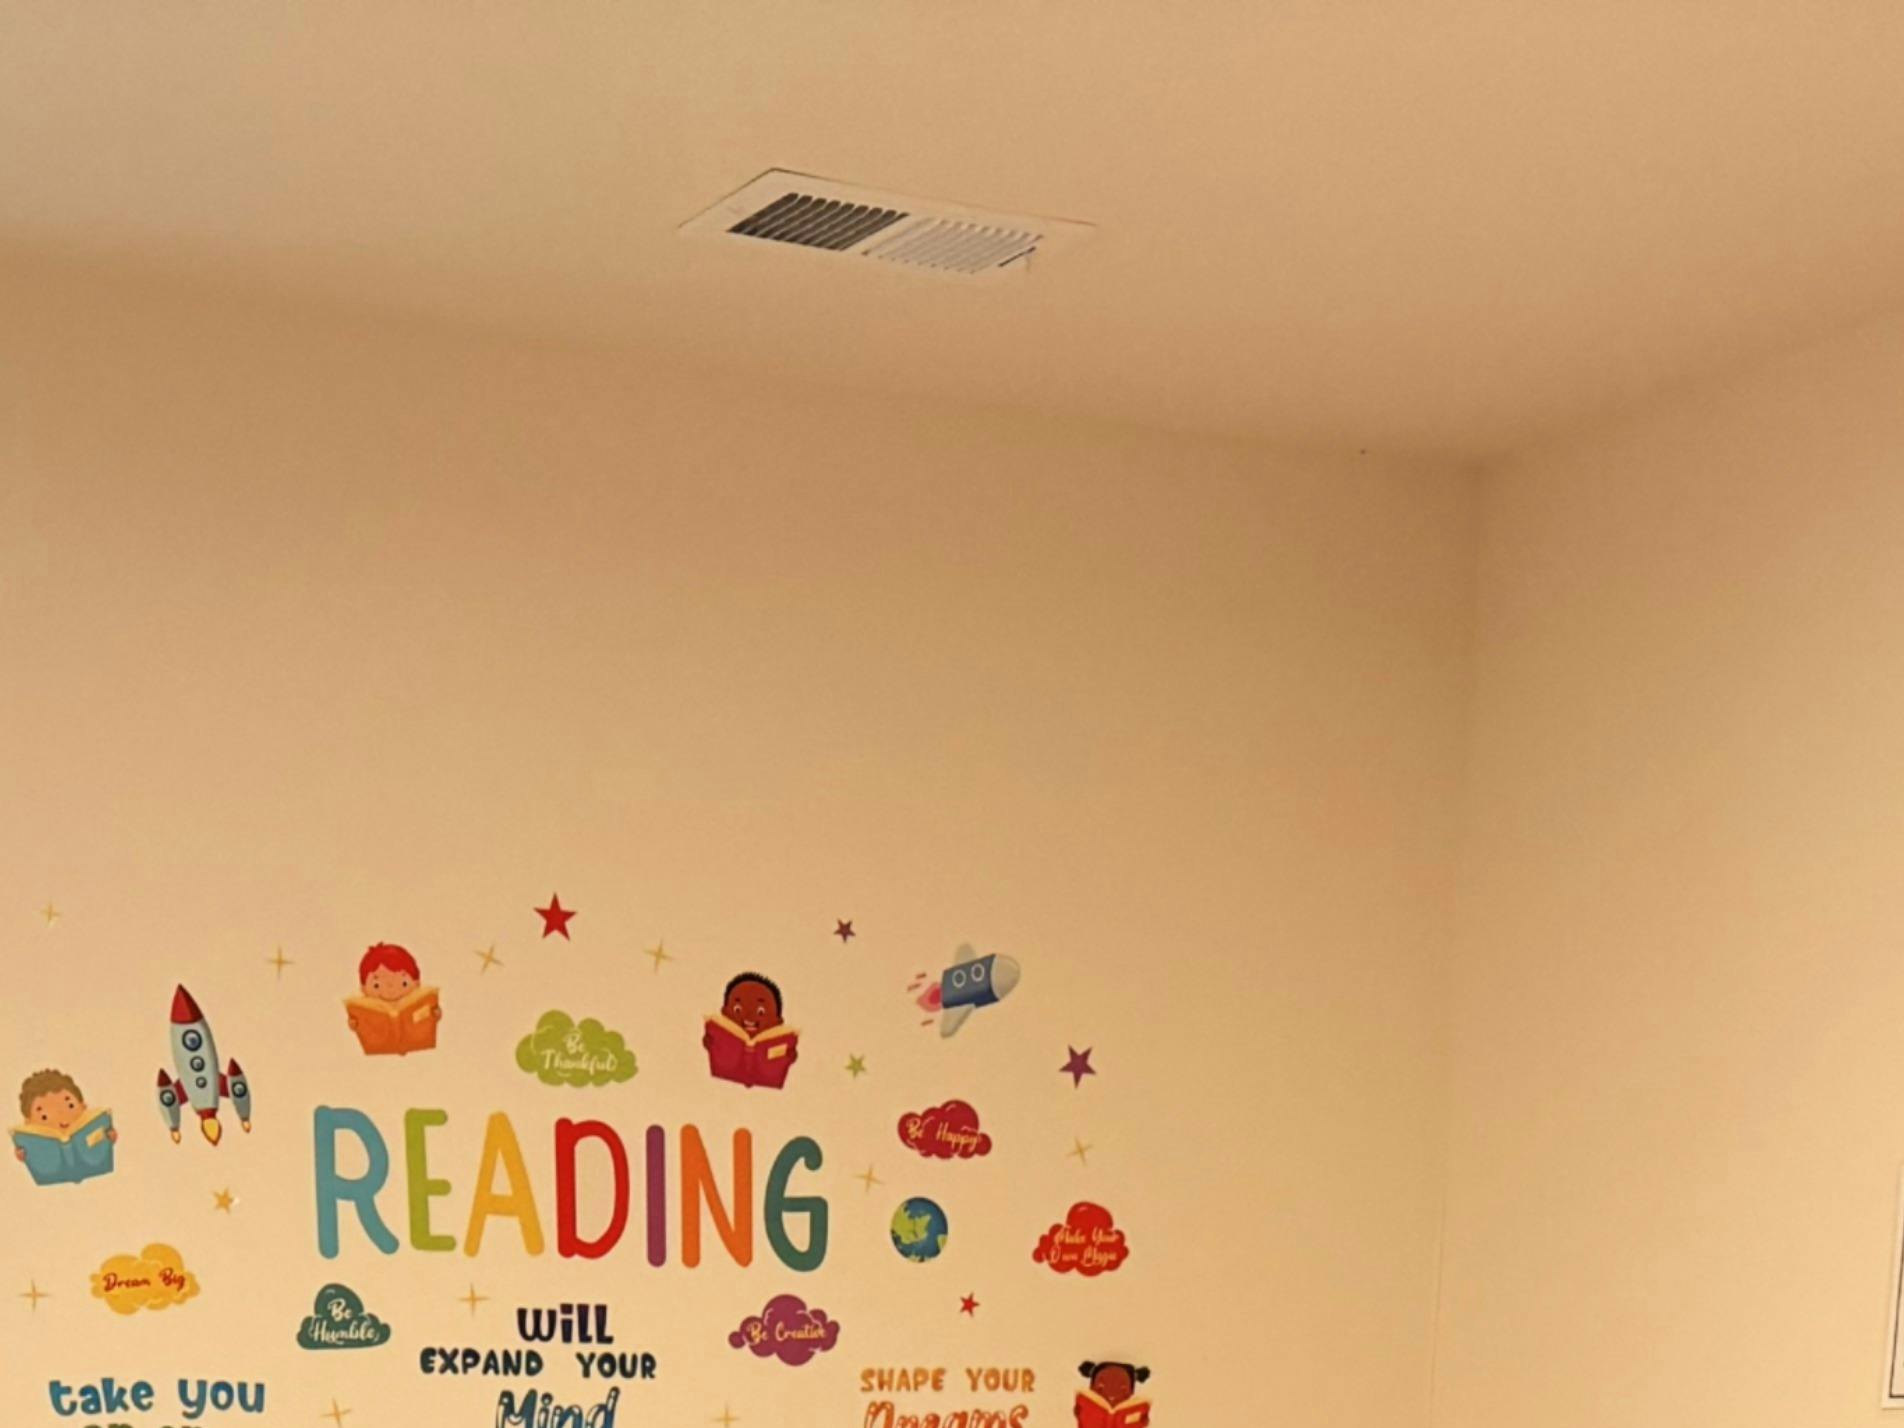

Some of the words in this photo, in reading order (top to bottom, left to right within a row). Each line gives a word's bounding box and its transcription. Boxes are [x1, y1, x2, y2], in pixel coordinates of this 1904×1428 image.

[564, 1031, 586, 1055] Be
[541, 1050, 617, 1077] Thankful
[907, 1117, 925, 1140] Be
[937, 1121, 984, 1154] Happy
[312, 1104, 829, 1273] READING
[103, 1272, 151, 1292] Dream
[159, 1269, 187, 1293] Big
[329, 1298, 352, 1321] Be
[746, 1321, 769, 1344] Be
[775, 1322, 827, 1343] Creative
[419, 1347, 544, 1377] EXPAND
[575, 1352, 657, 1379] YOUR
[860, 1367, 945, 1393] SHAPE
[966, 1367, 1036, 1393] YOUR
[49, 1376, 155, 1417] take
[178, 1379, 266, 1419] you
